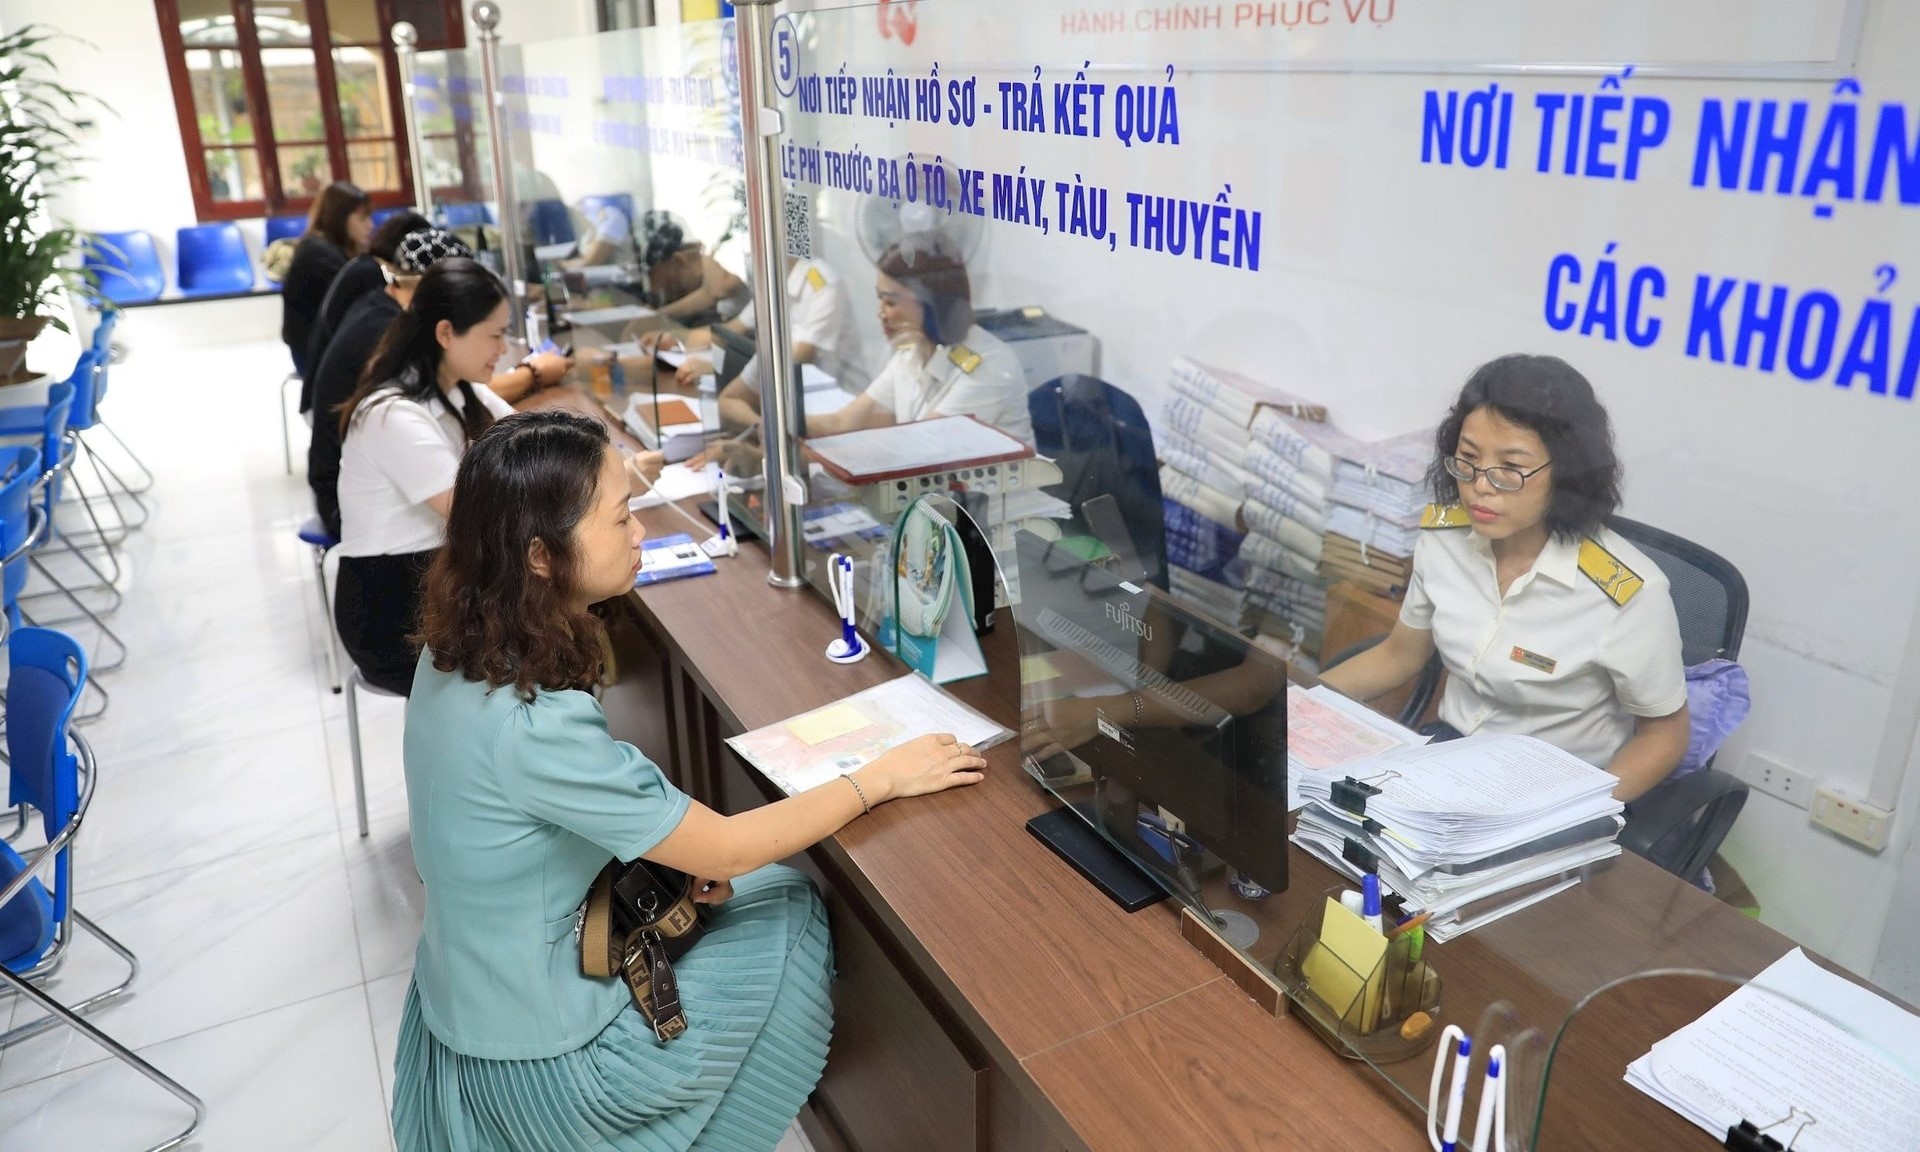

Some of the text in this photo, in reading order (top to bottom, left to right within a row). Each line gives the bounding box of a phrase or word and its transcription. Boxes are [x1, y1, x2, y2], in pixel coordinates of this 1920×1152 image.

[778, 31, 791, 81] 5
[1061, 0, 1394, 34] HÀNH CHÍNH PHỤC VỤ
[799, 72, 822, 113] NƠI
[825, 62, 857, 115] TIẾP
[862, 68, 910, 129] NHẬN
[916, 62, 941, 124] HỒ
[948, 76, 976, 127] SƠ
[999, 65, 1045, 133] TRẢ
[1054, 60, 1105, 138] KẾT
[1115, 64, 1180, 147] QUẢ
[1421, 65, 1920, 218] NƠI TIẾP NHẬN
[782, 139, 796, 188] LỆ
[799, 141, 821, 185] PHÍ
[825, 143, 873, 195] TRƯỚC
[878, 158, 900, 209] BẠ
[906, 152, 918, 203] Ô
[923, 155, 952, 215] TÔ,
[958, 168, 985, 216] XE
[993, 166, 1049, 236] MÁY,
[1055, 173, 1116, 252] TÀU,
[1127, 184, 1262, 272] THUYỀN
[1543, 242, 1668, 349] CÁC
[1105, 602, 1153, 642] FUJITSU
